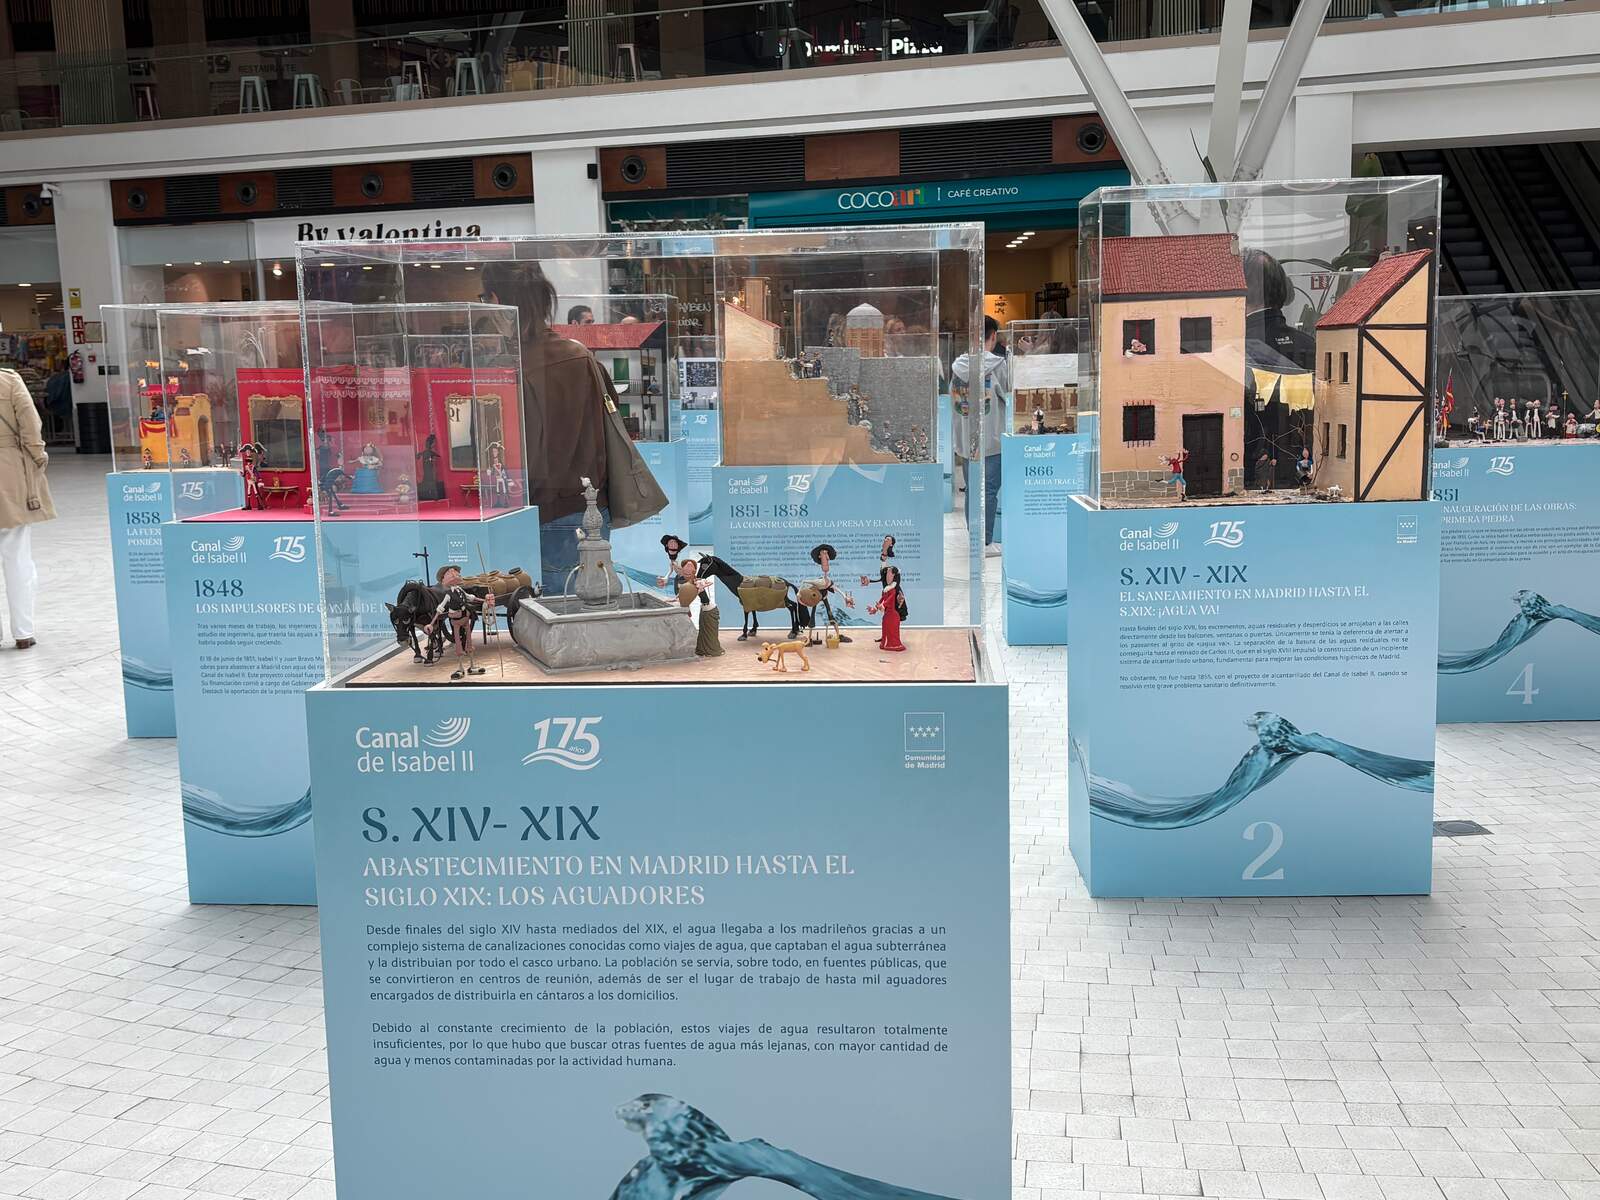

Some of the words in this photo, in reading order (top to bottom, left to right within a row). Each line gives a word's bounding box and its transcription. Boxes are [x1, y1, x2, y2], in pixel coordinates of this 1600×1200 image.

[948, 188, 971, 198] CAFÉ
[973, 186, 1019, 198] CREATIVO
[1025, 466, 1054, 476] 1866
[1432, 460, 1450, 469] anal
[1490, 456, 1515, 472] 175
[1440, 470, 1462, 478] Isabel
[122, 484, 144, 494] Canal
[728, 478, 750, 486] Canal
[787, 474, 811, 492] 175
[182, 482, 204, 498] 175
[728, 486, 738, 494] de
[740, 486, 762, 494] Isabel
[764, 486, 768, 494] II
[1433, 488, 1459, 502] 851
[123, 494, 133, 502] de
[134, 494, 156, 502] Isabel
[730, 504, 760, 518] 1851
[774, 504, 808, 518] 1858
[1442, 502, 1508, 514] NAUGURACIÓN
[1510, 504, 1524, 512] DE
[1525, 503, 1542, 512] LAS
[1543, 502, 1577, 511] OBRAS:
[126, 512, 160, 524] 1858
[742, 519, 809, 528] CONSTRUCCIÓN
[810, 520, 822, 528] DE
[824, 520, 835, 528] LA
[836, 519, 864, 528] PRESA
[865, 519, 872, 527] Y
[873, 519, 884, 527] EL
[884, 518, 914, 527] CANAL
[1482, 514, 1514, 523] PIEDRA
[1120, 527, 1152, 540] Canal
[1209, 521, 1246, 543] 175
[191, 540, 220, 552] Canal
[272, 536, 306, 558] 175
[1120, 540, 1134, 551] de
[1137, 540, 1170, 550] Isabel
[1172, 538, 1179, 550] II
[192, 553, 205, 564] de
[208, 552, 238, 564] Isabel
[240, 552, 246, 563] II
[1120, 568, 1140, 586] S.
[1146, 566, 1187, 585] XIV
[1207, 564, 1248, 584] XIX
[194, 579, 244, 598] 1848
[1120, 591, 1134, 602] EL
[1137, 589, 1231, 602] SANEAMIENTO
[1234, 588, 1251, 600] EN
[1254, 587, 1305, 599] MADRID
[1308, 586, 1350, 598] HASTA
[1354, 585, 1368, 596] EL
[196, 603, 218, 613] LOS
[221, 602, 295, 614] IMPULSORES
[298, 603, 314, 613] DE
[1120, 606, 1156, 618] S.XIX:
[1158, 605, 1196, 618] ¡AGUA
[1198, 604, 1219, 615] VA!
[1506, 664, 1540, 704] 4
[356, 726, 419, 749] Canal
[533, 716, 602, 763] 175
[357, 751, 384, 772] de
[392, 751, 456, 772] Isabel
[462, 750, 473, 772] II
[362, 806, 400, 842] S.
[519, 805, 600, 841] XIX
[1242, 821, 1284, 880] 2
[363, 856, 582, 876] ABASTECIMIENTO
[590, 856, 621, 874] EN
[630, 855, 728, 874] MADRID
[737, 855, 818, 874] HASTA
[826, 855, 854, 873] EL
[365, 886, 436, 906] SIGLO
[443, 887, 491, 905] XIX:
[499, 886, 544, 905] LOS
[552, 885, 704, 905] AGUADORES
[366, 924, 400, 936] Desde
[405, 923, 442, 936] finales
[447, 923, 464, 934] del
[469, 924, 496, 936] siglo
[501, 924, 520, 934] XIV
[526, 923, 556, 934] hasta
[562, 923, 617, 936] mediados
[622, 923, 639, 934] del
[645, 923, 667, 934] XIX,
[672, 922, 682, 933] el
[687, 925, 715, 936] agua
[721, 922, 762, 936] llegaba
[768, 925, 774, 933] a
[780, 922, 796, 936] los
[802, 922, 866, 936] madrileños
[872, 924, 913, 935] gracias
[918, 926, 924, 934] a
[930, 926, 945, 934] un
[367, 940, 418, 954] complejo
[422, 941, 464, 952] sistema
[468, 940, 481, 951] de
[484, 940, 566, 951] canalizaciones
[568, 939, 625, 950] conocidas
[628, 942, 660, 950] como
[663, 940, 695, 953] viajes
[697, 939, 714, 952] de
[715, 942, 746, 953] agua,
[750, 942, 771, 953] que
[774, 939, 827, 953] captaban
[830, 939, 840, 950] el
[844, 942, 872, 953] agua
[876, 940, 946, 952] subterránea
